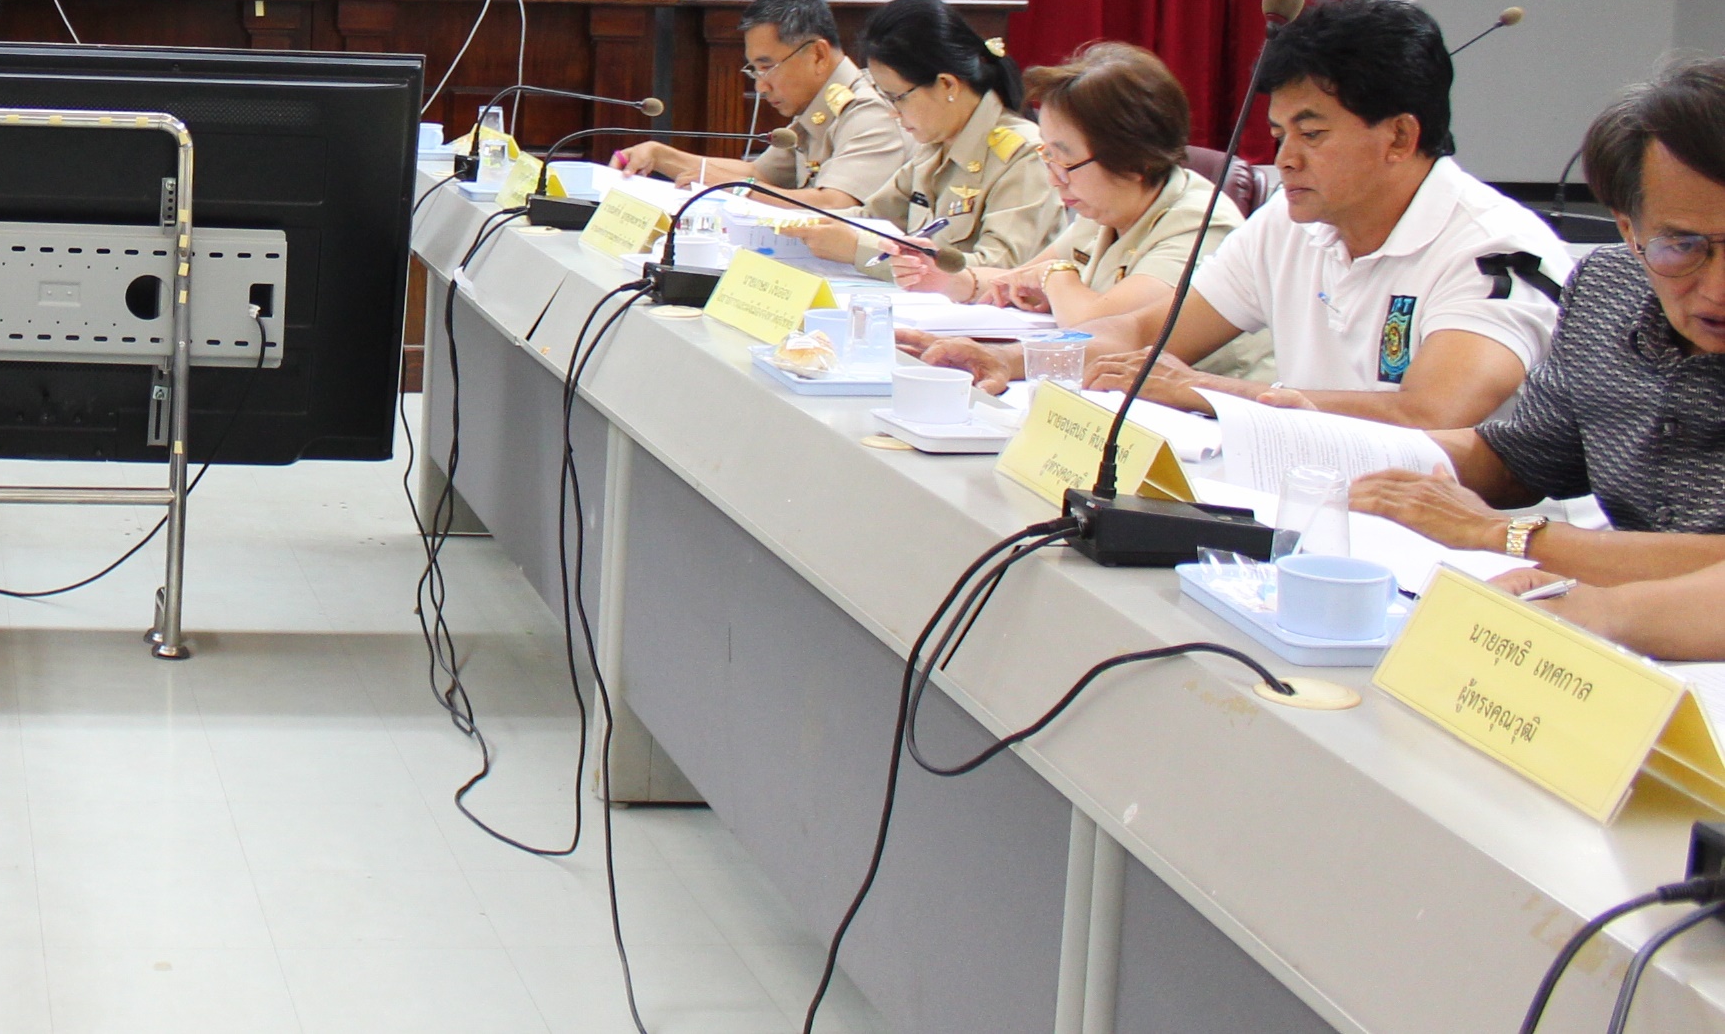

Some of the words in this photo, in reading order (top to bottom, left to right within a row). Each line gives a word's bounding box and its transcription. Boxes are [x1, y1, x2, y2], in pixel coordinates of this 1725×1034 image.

[1469, 623, 1533, 667] นายสุทธิ
[1533, 657, 1594, 703] เทศกาล
[1455, 677, 1541, 745] ผู้ทรงคุณวุฒิ
